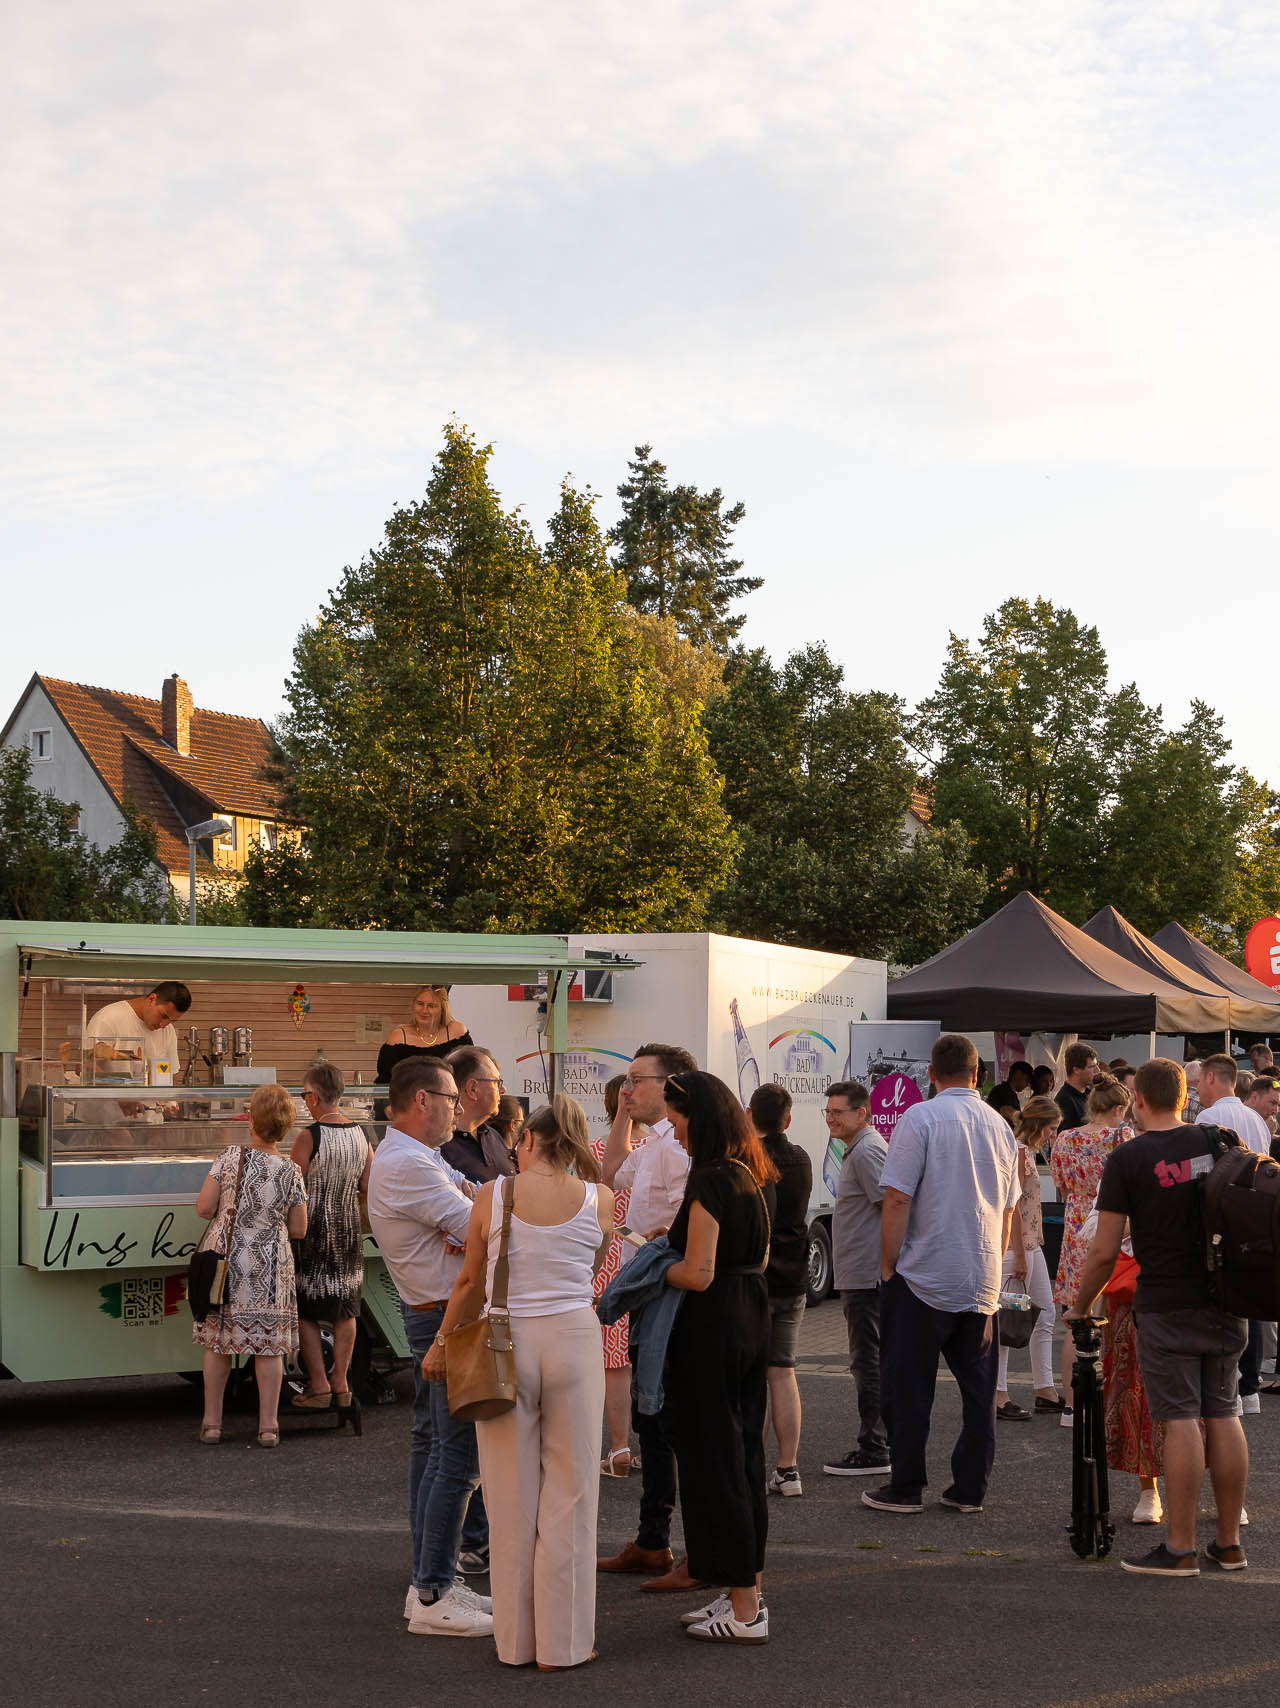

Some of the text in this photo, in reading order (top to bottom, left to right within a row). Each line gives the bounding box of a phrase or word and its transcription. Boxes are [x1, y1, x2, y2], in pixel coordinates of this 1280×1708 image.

[796, 1058, 811, 1073] BAD
[564, 1068, 588, 1080] BAD
[44, 1210, 138, 1268] Uns
[123, 1319, 144, 1327] Scan
